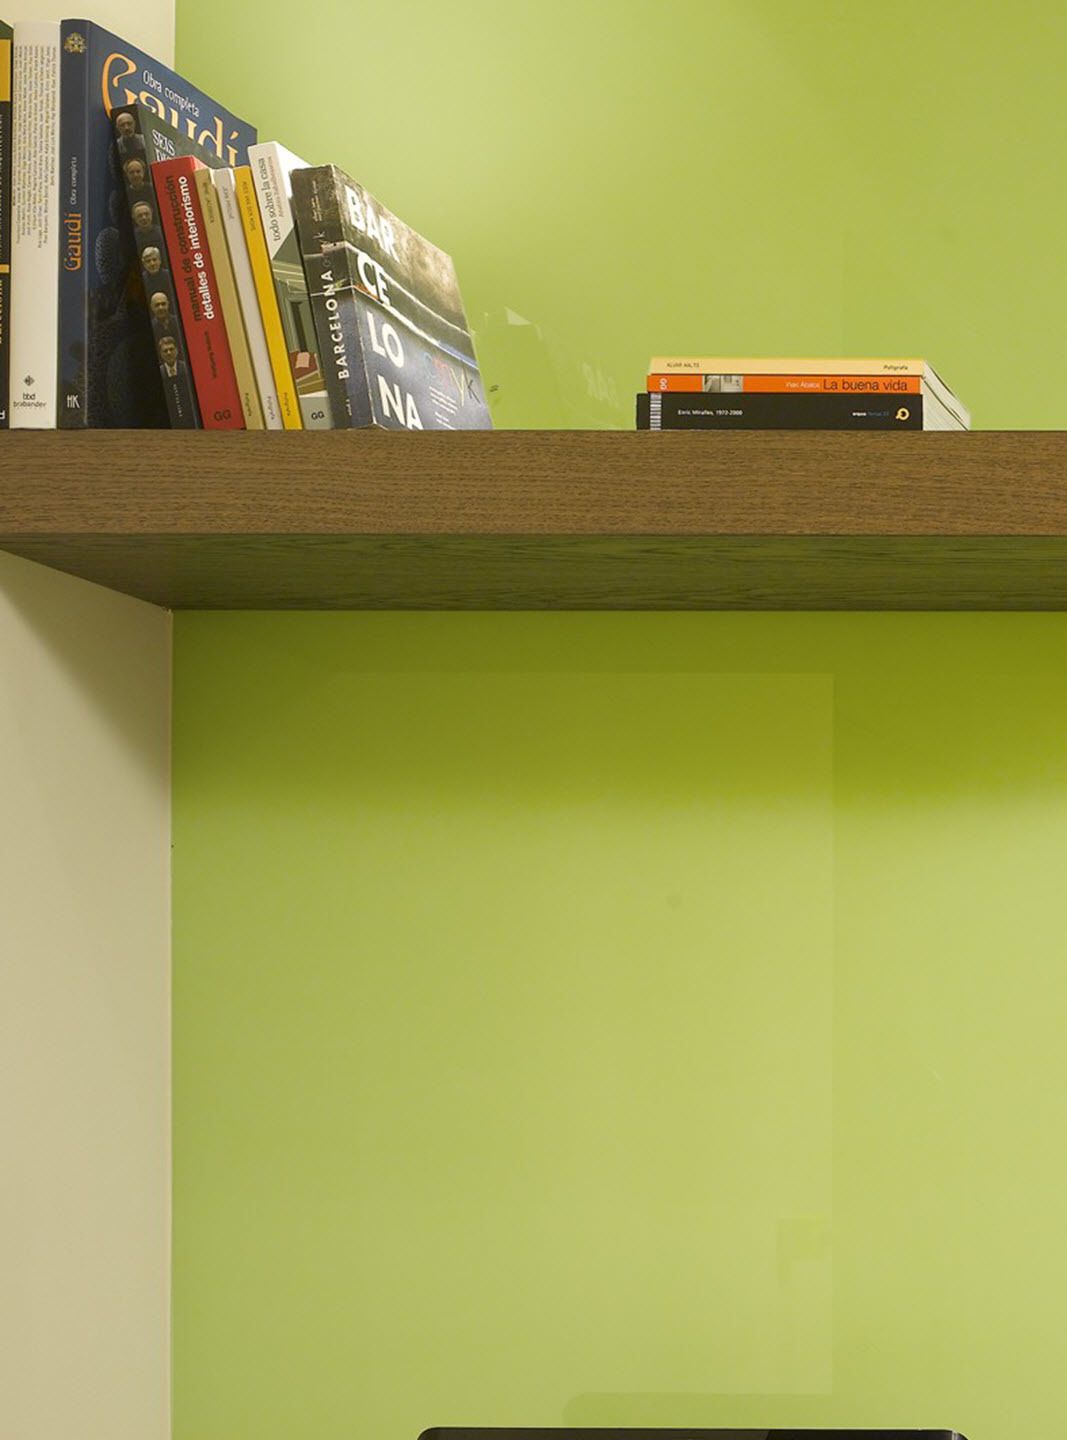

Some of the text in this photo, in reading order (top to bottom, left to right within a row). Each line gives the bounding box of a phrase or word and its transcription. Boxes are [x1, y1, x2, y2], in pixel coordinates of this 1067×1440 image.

[143, 70, 201, 118] Obra completa
[258, 158, 268, 180] casa
[261, 180, 271, 192] la
[178, 176, 201, 251] interiorismo
[263, 192, 275, 220] sobre
[268, 219, 281, 242] todo
[345, 184, 401, 264] BAR
[64, 213, 82, 271] Gaudí
[165, 175, 202, 321] manual de construcción
[193, 252, 204, 269] de
[198, 271, 215, 321] detalles
[357, 251, 392, 307] CE
[321, 269, 350, 381] BARCELONA
[366, 310, 405, 369] LO
[376, 374, 425, 430] NA
[823, 379, 908, 391] La buena vida
[213, 409, 231, 421] GG
[311, 411, 325, 420] GG
